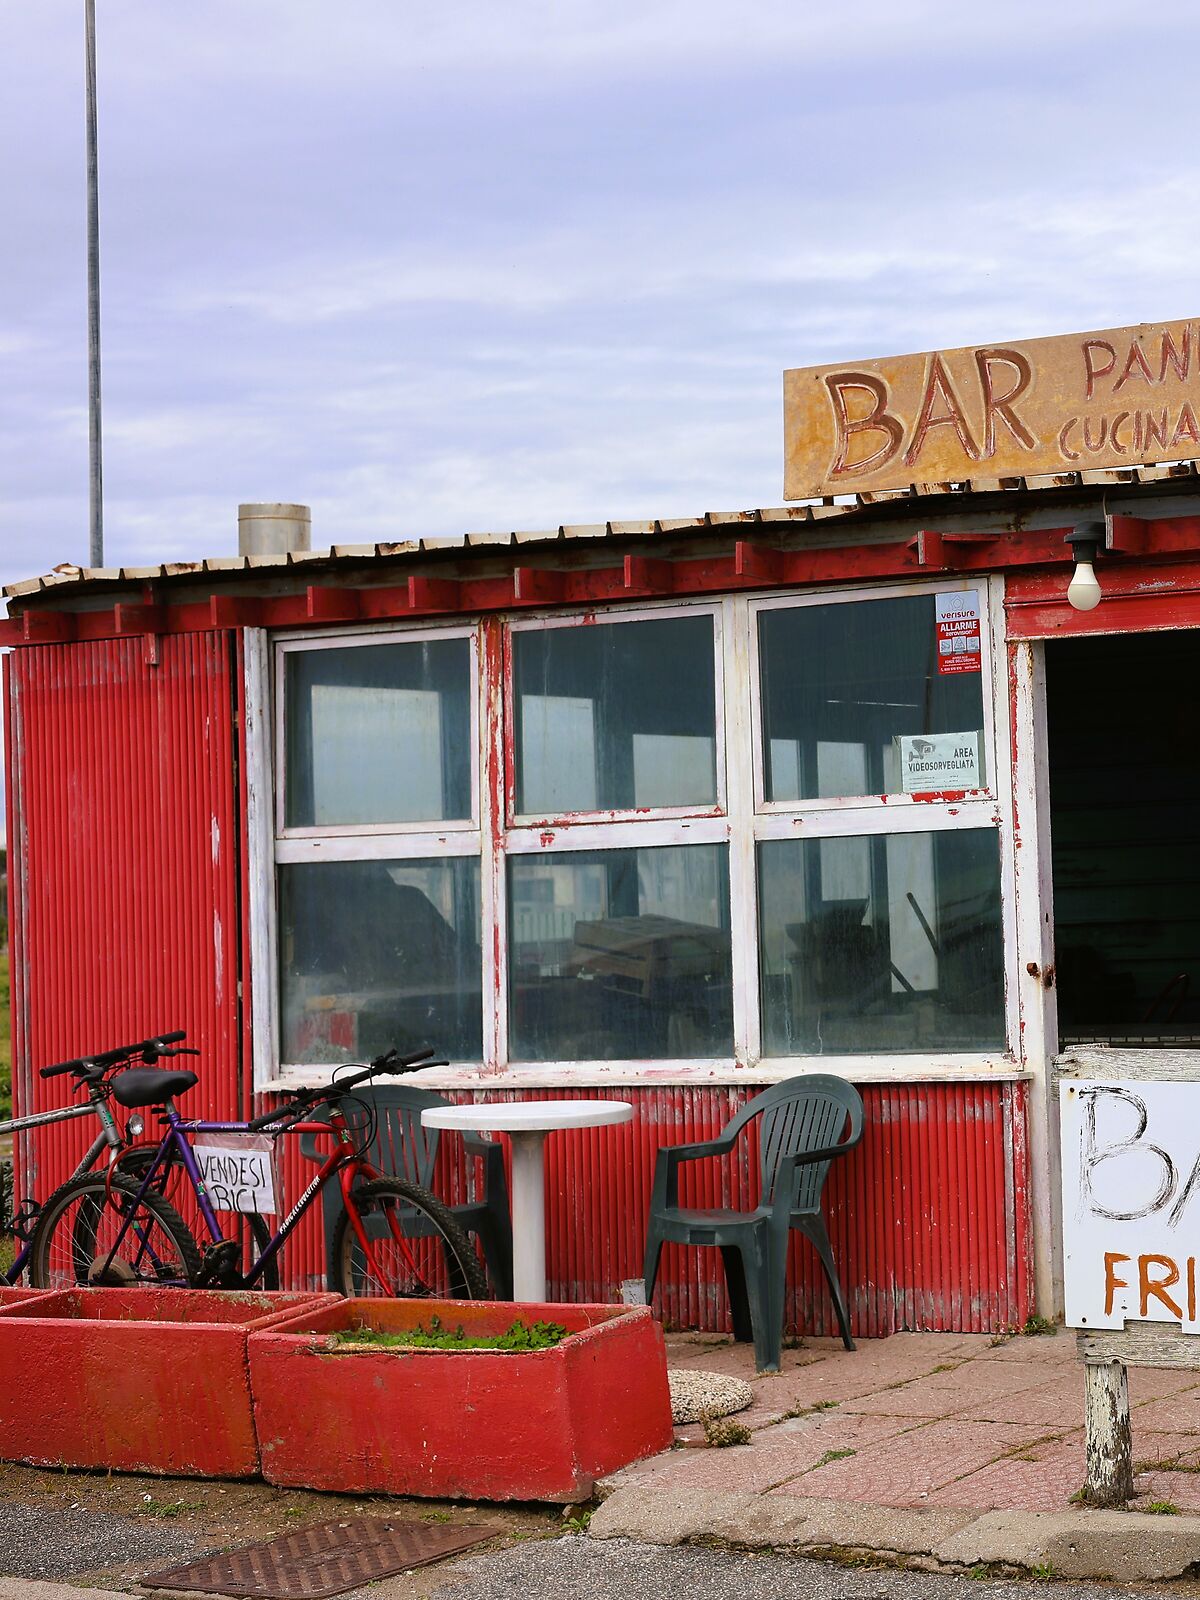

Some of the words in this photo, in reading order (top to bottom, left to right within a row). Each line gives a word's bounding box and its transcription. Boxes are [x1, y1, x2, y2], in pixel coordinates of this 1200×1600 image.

[823, 348, 1040, 481] BAR
[1058, 400, 1200, 460] CUCINA
[940, 610, 975, 619] verisure
[940, 621, 978, 632] ALLARME
[953, 747, 974, 758] AREA
[908, 759, 974, 772] VIDEOSORVEGLIATA
[197, 1153, 266, 1188] VENDESI
[211, 1184, 258, 1213] BICI
